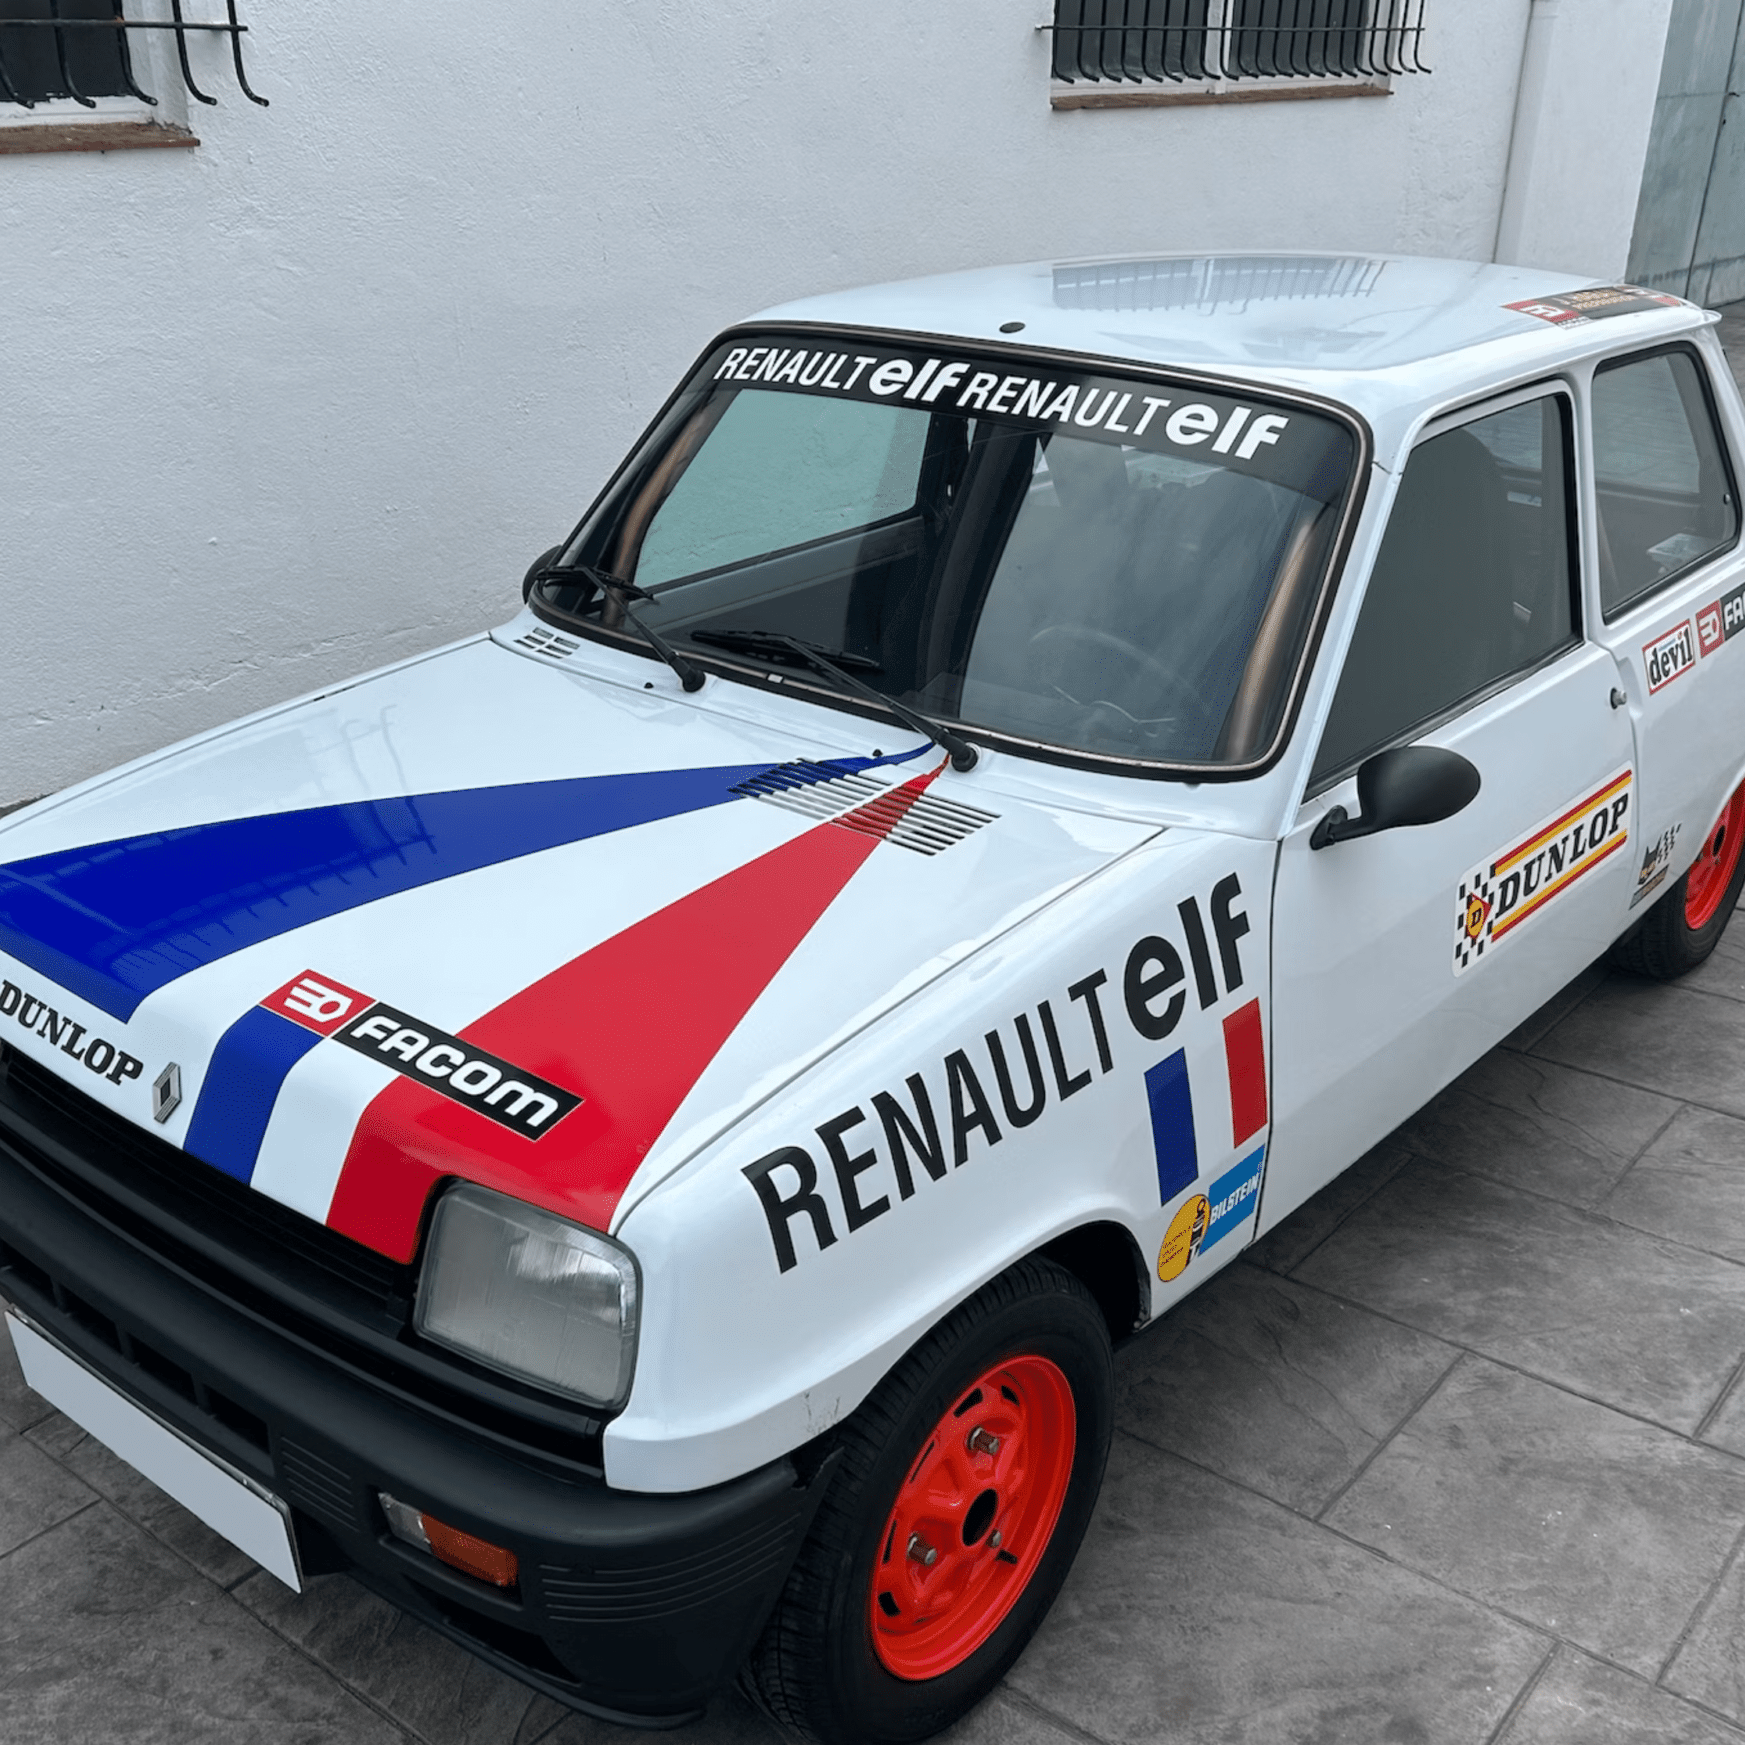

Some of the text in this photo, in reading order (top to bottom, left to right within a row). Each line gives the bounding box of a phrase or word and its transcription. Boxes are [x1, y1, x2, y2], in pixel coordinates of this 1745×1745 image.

[713, 347, 1290, 460] RENAULT elf RENAULT elf
[1649, 627, 1693, 685] devil
[1495, 792, 1629, 919] DUNLOP
[1470, 907, 1482, 928] D
[0, 979, 144, 1086] DUNLOP
[350, 1014, 560, 1127] FACOM
[741, 872, 1251, 1275] RENAULT elf
[1209, 1172, 1260, 1226] BILSTEIN
